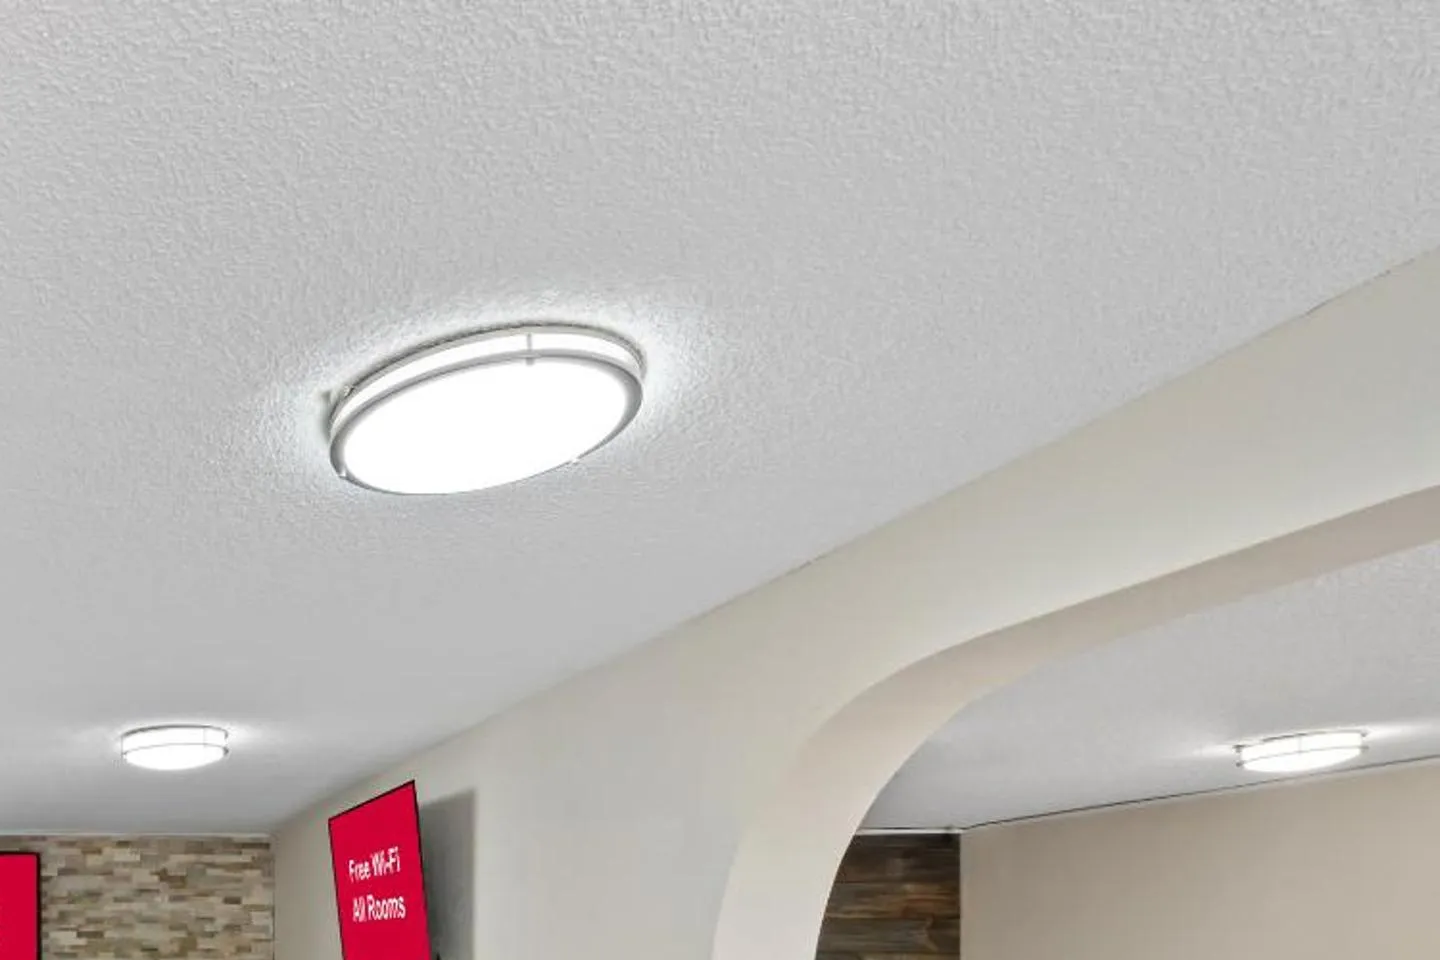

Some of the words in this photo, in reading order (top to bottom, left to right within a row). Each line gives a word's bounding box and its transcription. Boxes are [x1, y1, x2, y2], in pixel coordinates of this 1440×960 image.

[348, 859, 371, 882] Free
[371, 846, 401, 876] Wi-Fi
[352, 897, 367, 922] All
[366, 894, 406, 921] Rooms
